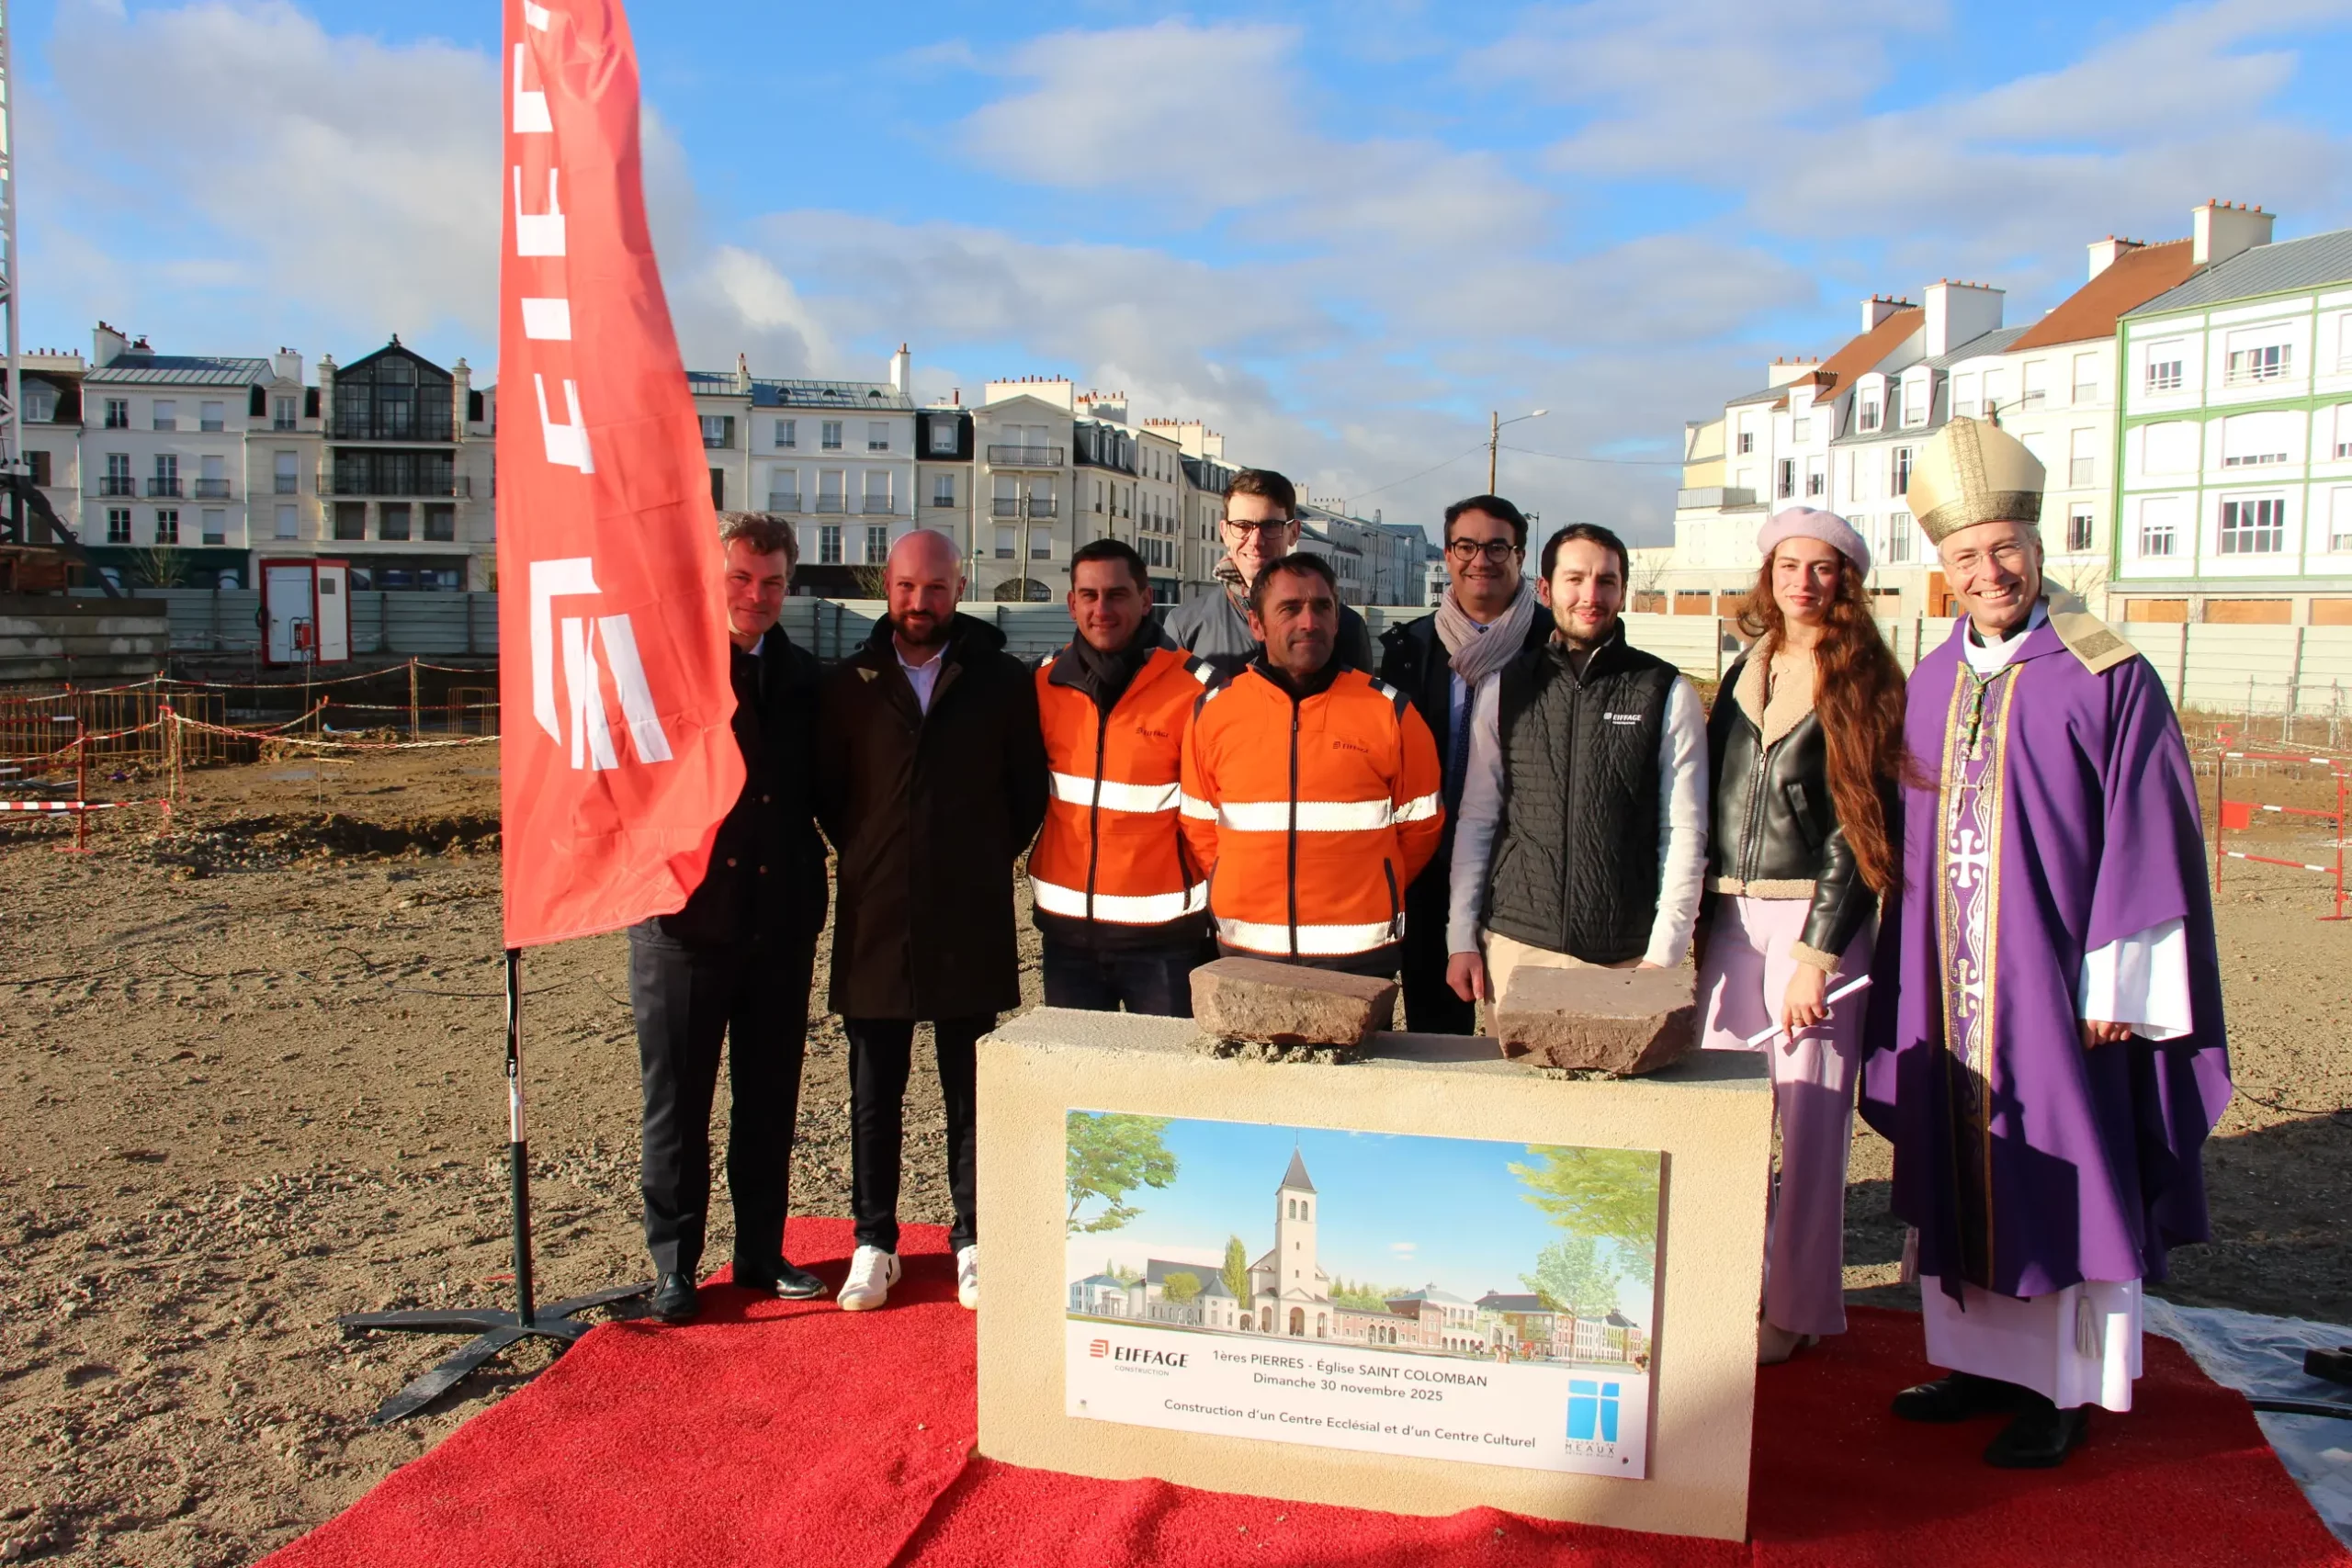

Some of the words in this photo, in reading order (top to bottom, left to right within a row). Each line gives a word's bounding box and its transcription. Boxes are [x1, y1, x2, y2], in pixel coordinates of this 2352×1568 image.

[1114, 1346, 1190, 1368] EIFFAGE
[1213, 1349, 1248, 1364] 1ères
[1250, 1354, 1305, 1370] PIERRES
[1317, 1358, 1355, 1375] Église
[1359, 1364, 1400, 1379] SAINT
[1404, 1369, 1488, 1387] COLOMBAN
[1114, 1364, 1170, 1377] CONSTRUCTION
[1253, 1372, 1316, 1389] Dimanche
[1320, 1379, 1338, 1391] 30
[1340, 1382, 1406, 1398] novembre
[1410, 1388, 1443, 1402] 2025
[1164, 1399, 1243, 1417] Construction
[1279, 1412, 1323, 1427] Centre
[1327, 1416, 1380, 1433] Ecclésial
[1385, 1425, 1397, 1435] et
[1434, 1427, 1479, 1443] Centre
[1483, 1433, 1536, 1449] Culturel
[1565, 1443, 1615, 1455] MEAUX
